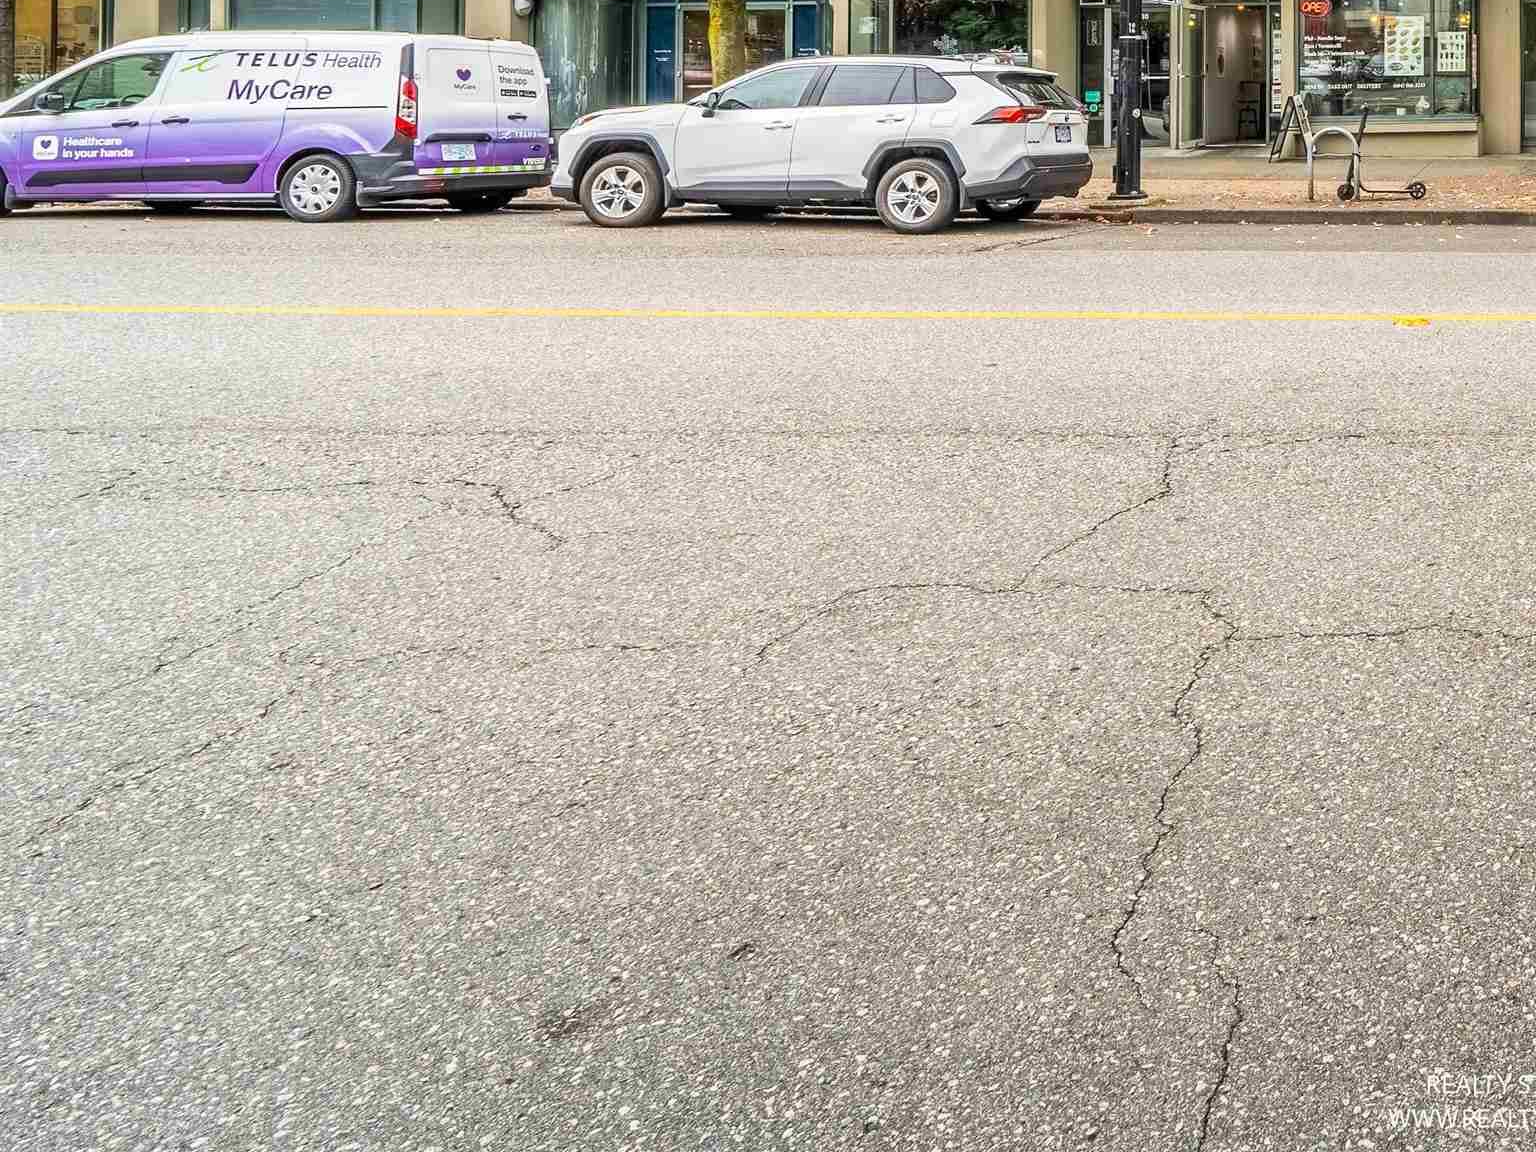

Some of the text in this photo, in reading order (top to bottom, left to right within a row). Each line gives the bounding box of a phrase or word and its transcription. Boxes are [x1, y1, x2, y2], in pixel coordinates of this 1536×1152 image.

[236, 53, 382, 69] TELUS Health
[498, 65, 535, 76] Download
[500, 76, 513, 84] the
[226, 79, 333, 105] MyCare
[63, 136, 122, 146] Healthcare
[62, 148, 73, 158] in
[74, 149, 99, 160] your
[100, 148, 134, 158] hands
